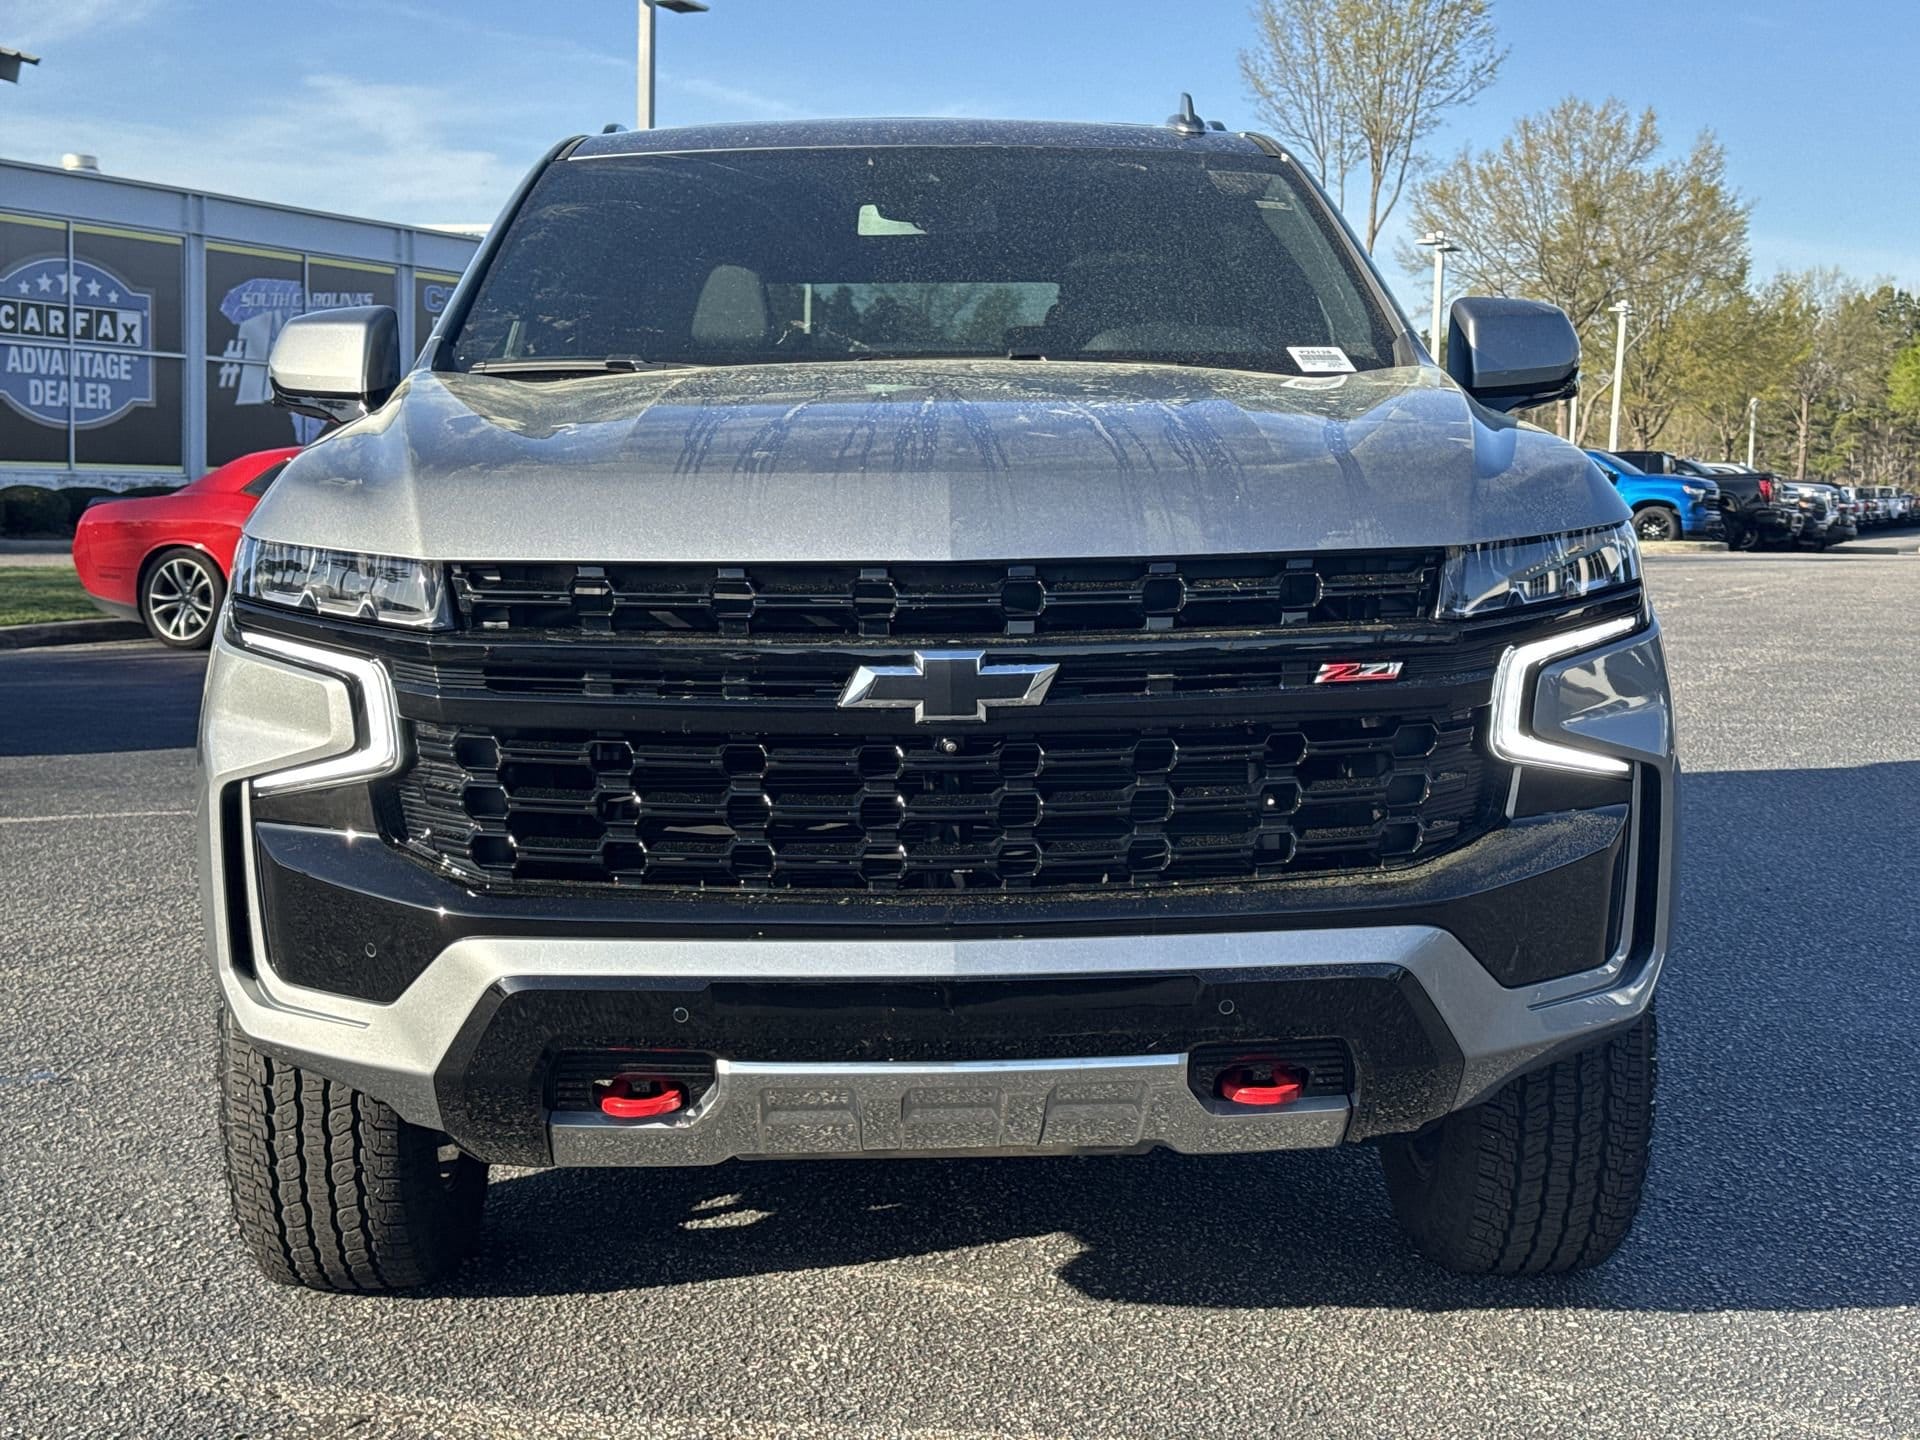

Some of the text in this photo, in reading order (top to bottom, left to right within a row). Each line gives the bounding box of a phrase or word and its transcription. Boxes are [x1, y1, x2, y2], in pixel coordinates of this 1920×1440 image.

[240, 292, 291, 307] SOUTH
[0, 304, 138, 344] CARFAX
[6, 346, 133, 380] ADVANTAGE
[28, 378, 112, 410] DEALER
